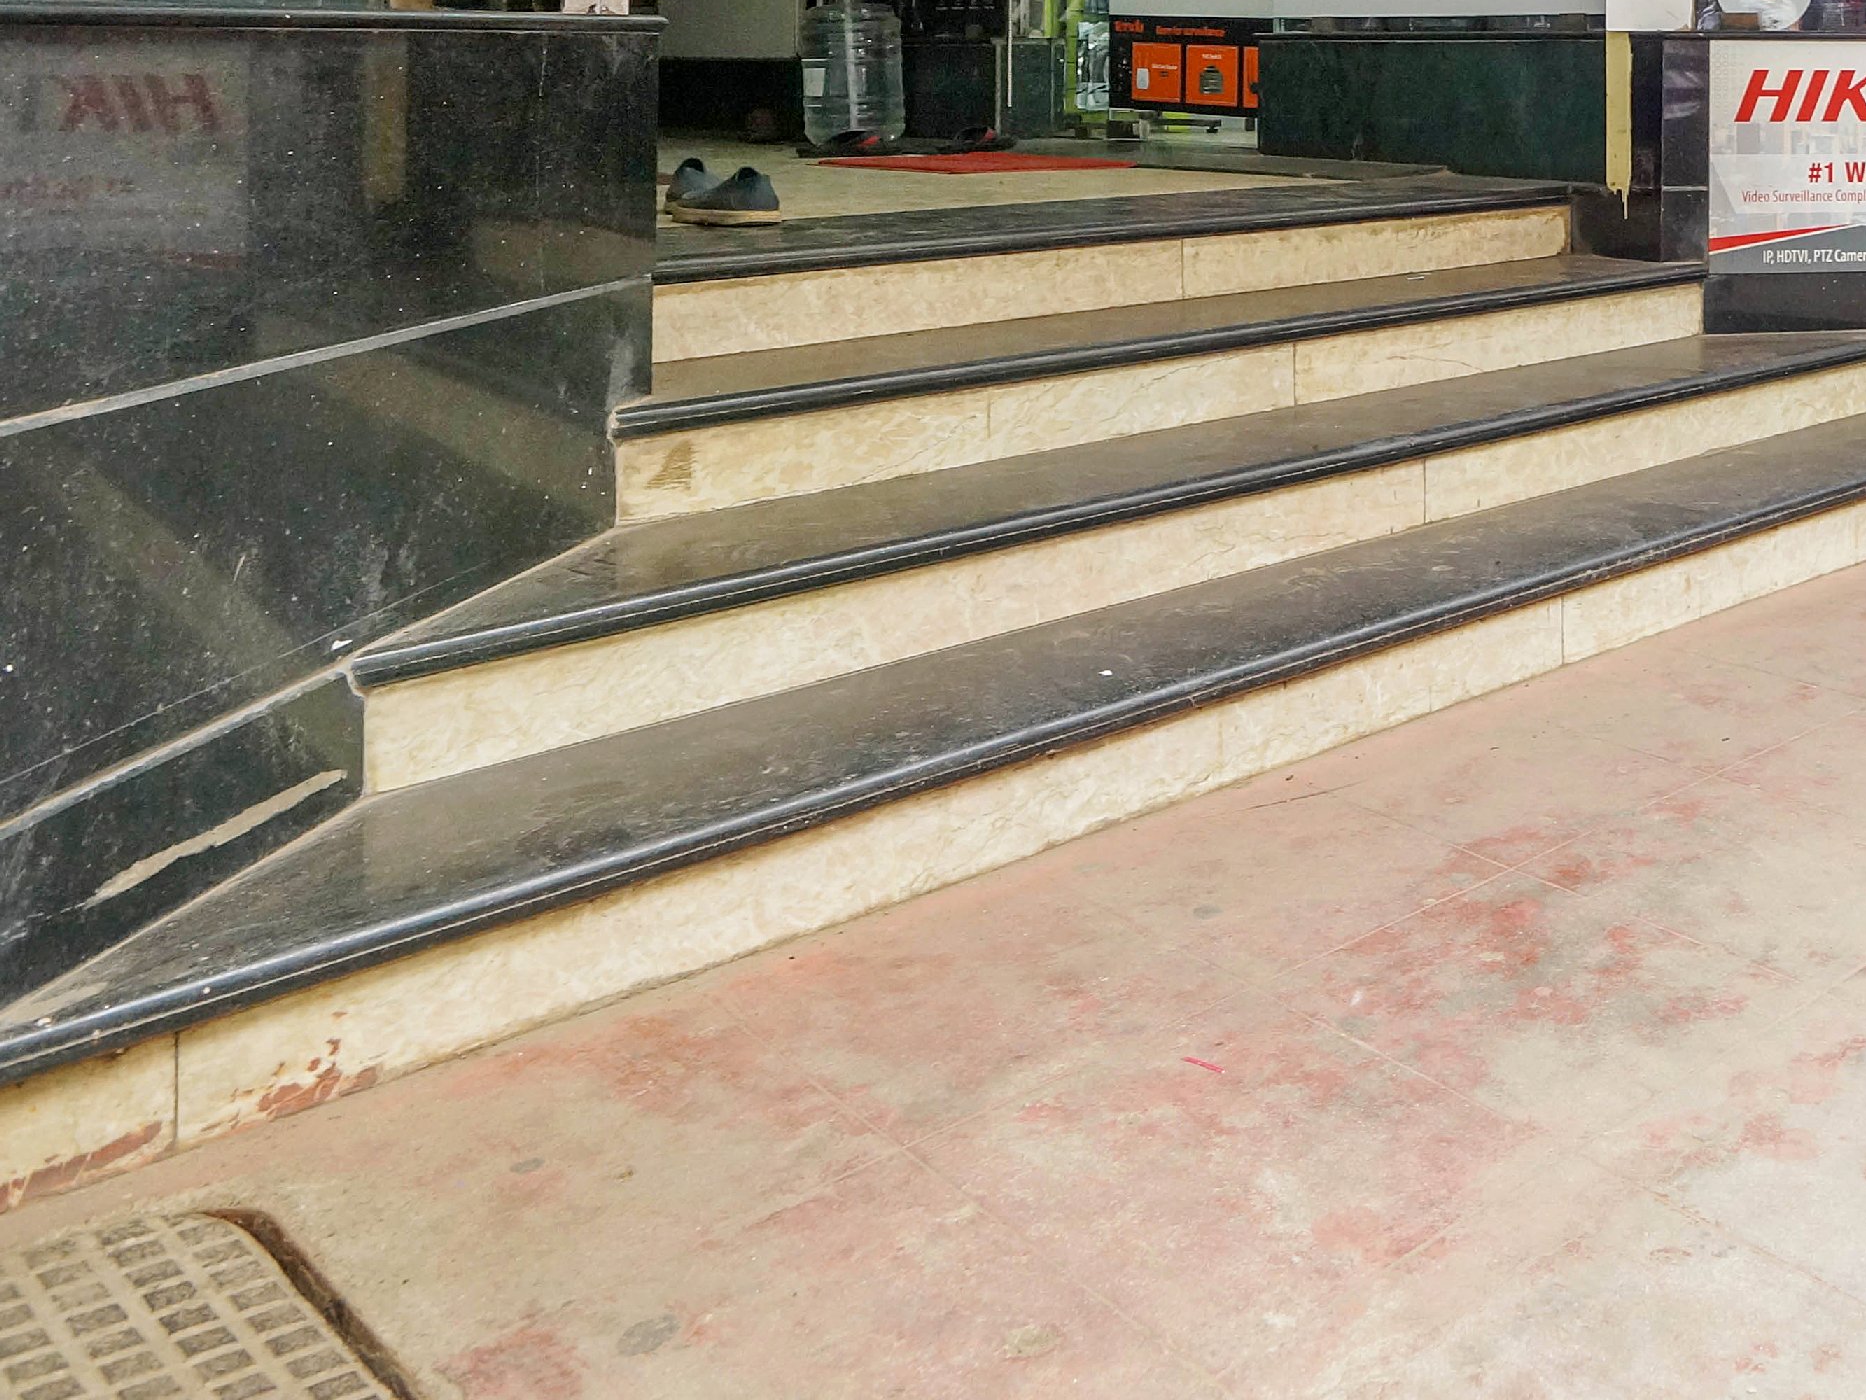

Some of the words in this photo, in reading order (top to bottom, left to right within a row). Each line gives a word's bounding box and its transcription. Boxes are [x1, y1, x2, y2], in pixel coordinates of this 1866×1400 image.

[1808, 163, 1834, 184] #1
[1741, 190, 1770, 203] Video
[1771, 189, 1834, 204] Surveillance
[1776, 249, 1812, 265] HDTVI,
[1813, 248, 1832, 263] PTZ
